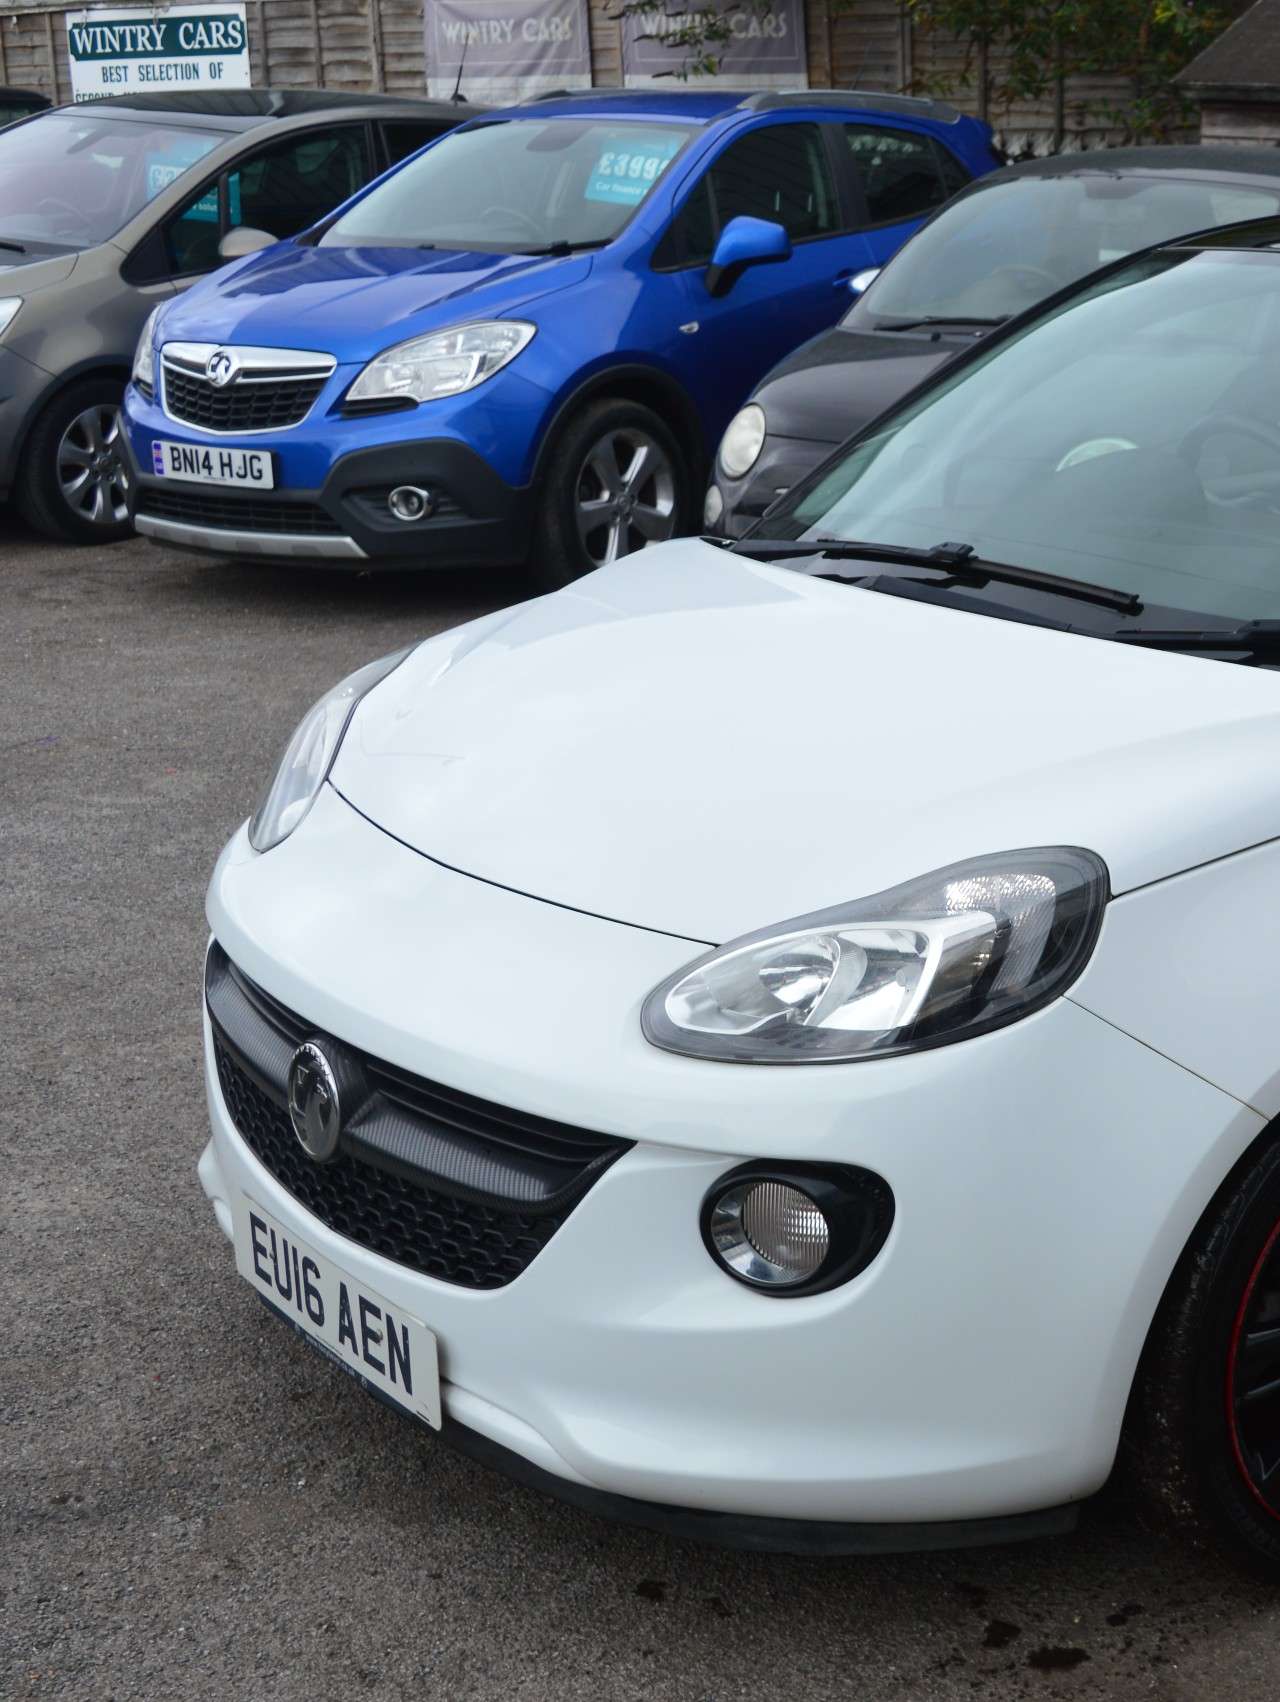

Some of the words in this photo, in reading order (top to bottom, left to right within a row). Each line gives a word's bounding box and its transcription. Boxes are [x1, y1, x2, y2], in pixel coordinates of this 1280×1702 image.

[72, 24, 166, 54] WINTRY
[178, 20, 243, 50] CARS
[442, 18, 515, 45] WINTRY
[522, 16, 572, 43] CARS
[730, 13, 787, 39] CARS
[101, 65, 129, 83] BEST
[138, 62, 200, 82] SELECTION
[209, 61, 224, 80] OF
[170, 446, 214, 476] BN14
[219, 451, 263, 481] HJG
[249, 1210, 325, 1328] EU16
[338, 1280, 413, 1396] AEN
